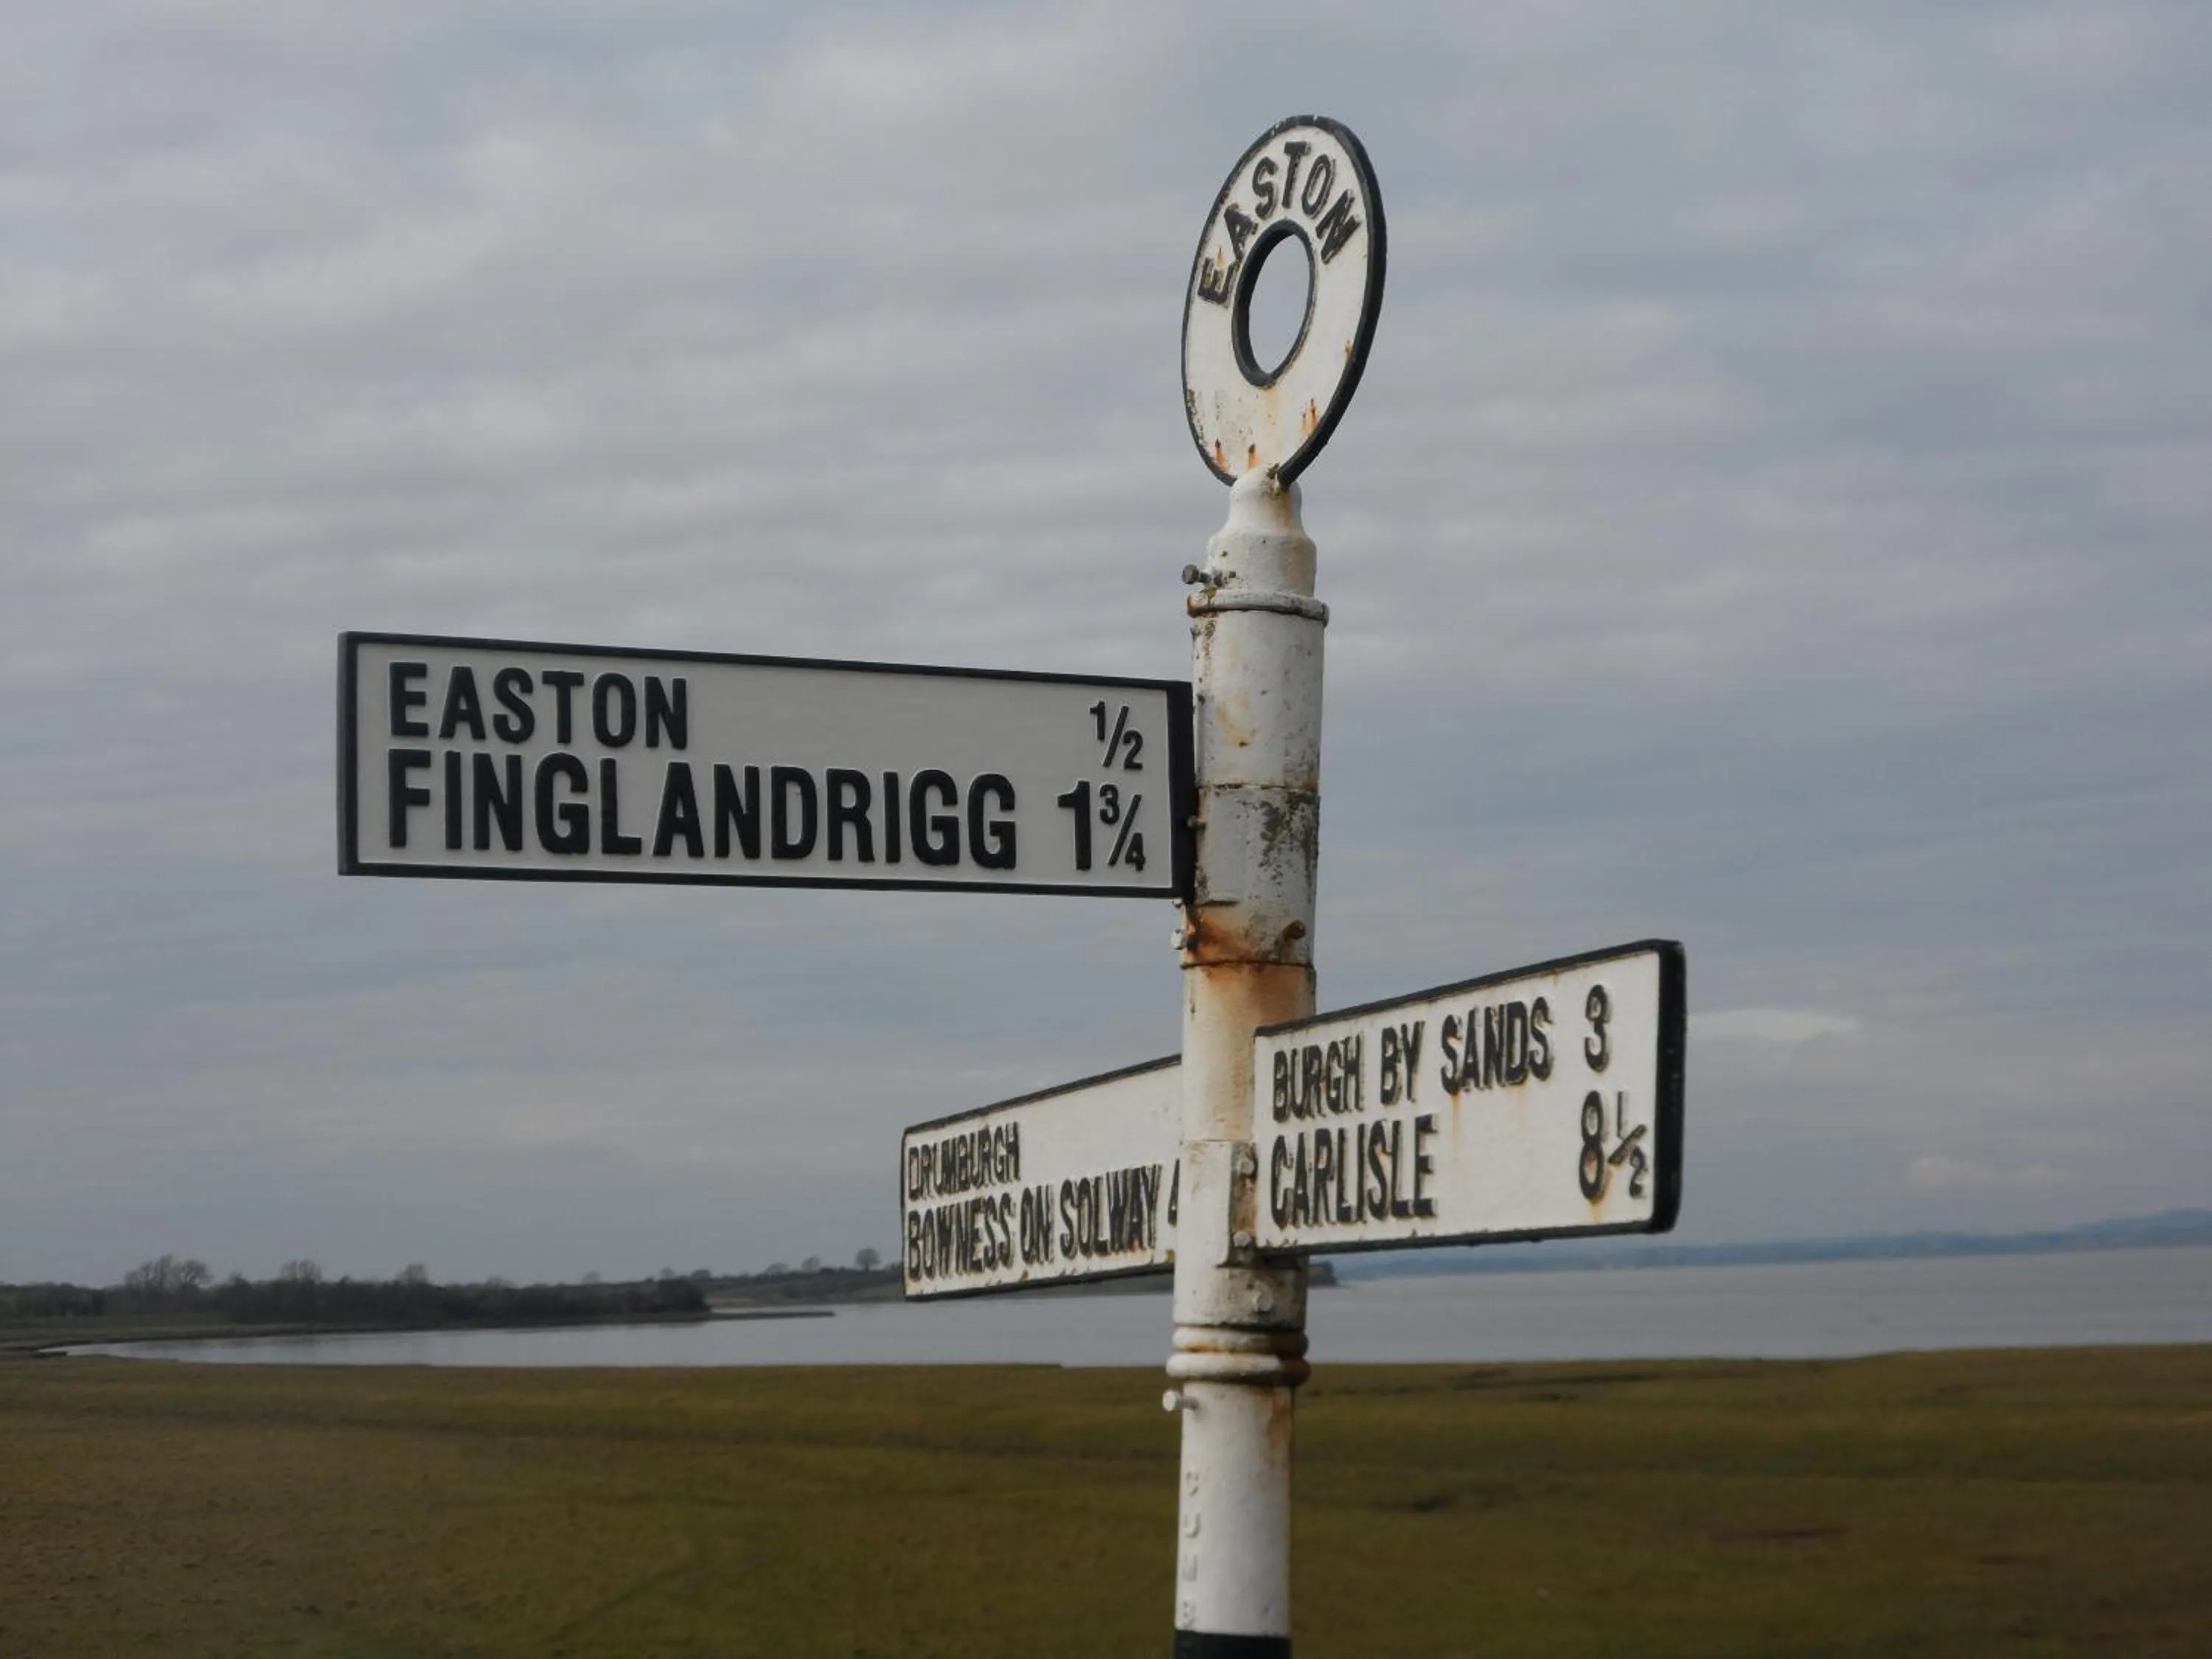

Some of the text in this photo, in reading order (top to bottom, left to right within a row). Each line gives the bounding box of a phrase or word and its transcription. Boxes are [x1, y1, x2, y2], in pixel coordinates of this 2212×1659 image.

[1197, 142, 1360, 305] EASTON
[389, 662, 687, 749] EASTON
[389, 749, 1016, 870] FINGLANDRIGG
[1273, 984, 1609, 1122] BURGH BY SANDS 3
[908, 1121, 1020, 1201] DRUMBURGH
[1270, 1114, 1439, 1229] CARLISLE
[908, 1192, 1015, 1281] BOWNESS
[1020, 1183, 1054, 1265] ON
[1060, 1164, 1163, 1258] SOLWAY
